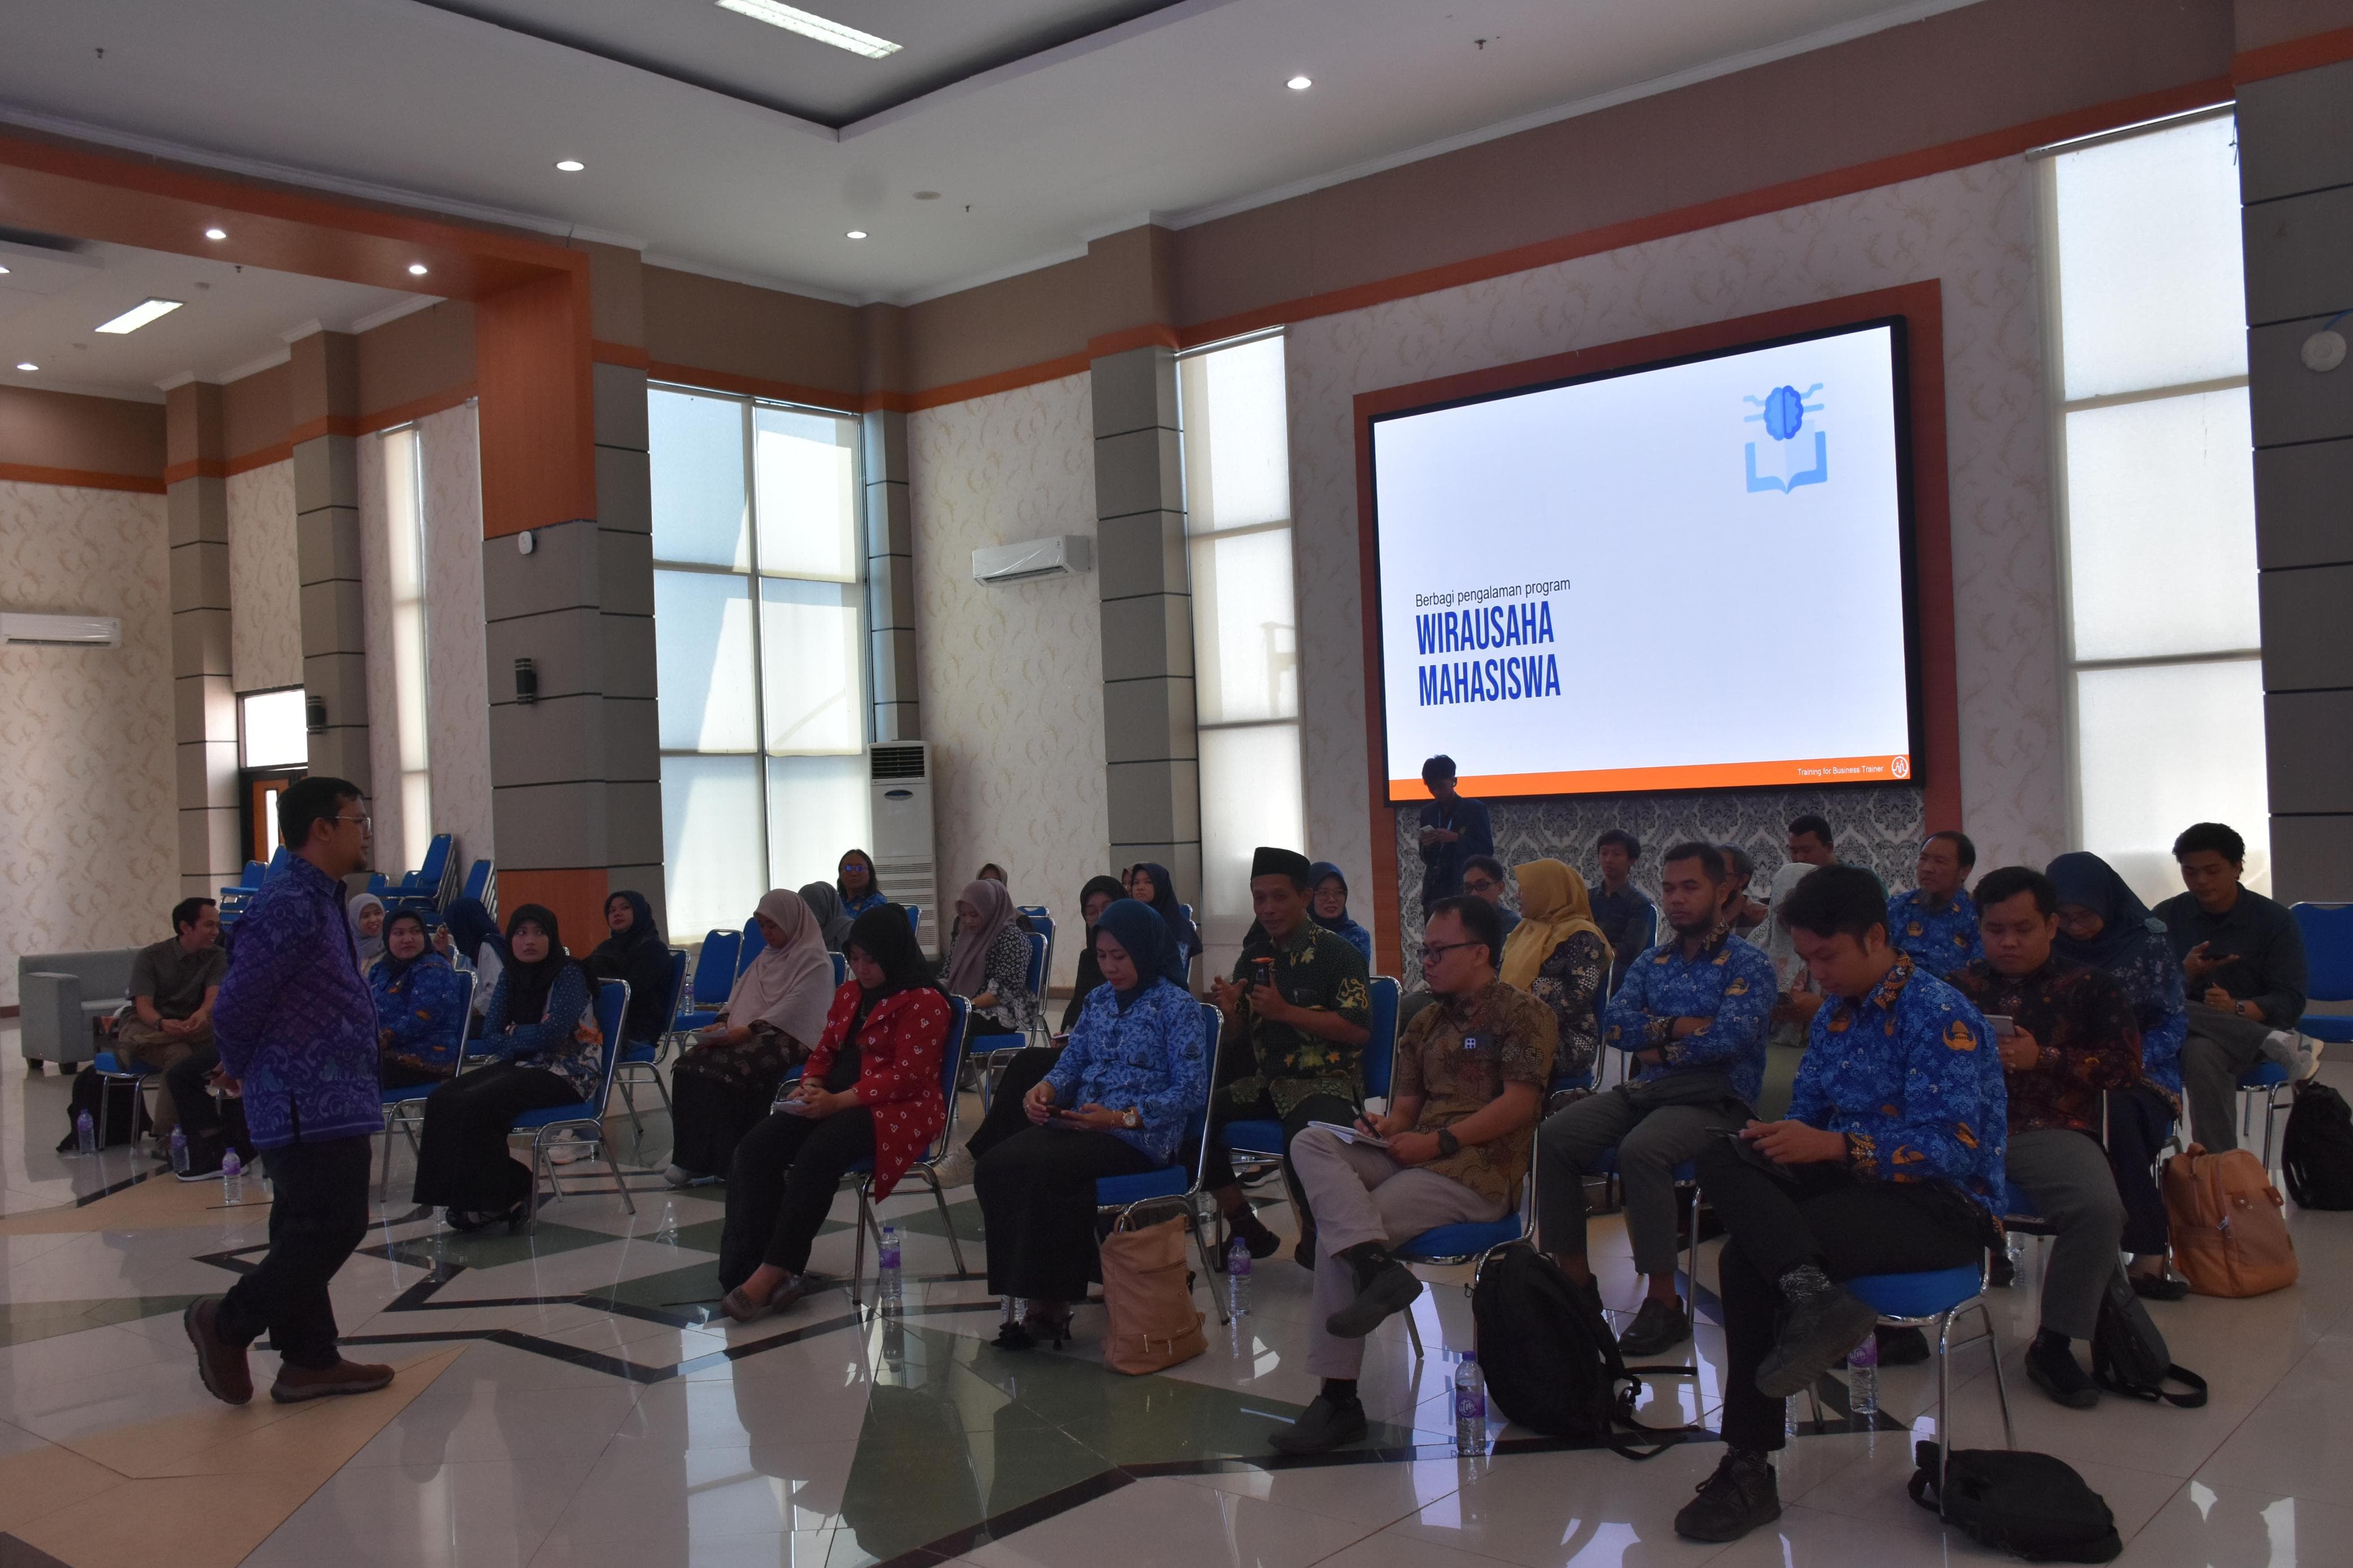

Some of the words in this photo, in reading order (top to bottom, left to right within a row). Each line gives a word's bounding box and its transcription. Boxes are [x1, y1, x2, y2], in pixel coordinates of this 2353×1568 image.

[1416, 590, 1454, 607] Berbagi
[1458, 585, 1522, 605] pengalaman
[1525, 579, 1570, 598] program
[1416, 601, 1554, 655] WIRAUSAHA
[1419, 654, 1561, 706] MAHASISWA
[1798, 767, 1822, 776] Training
